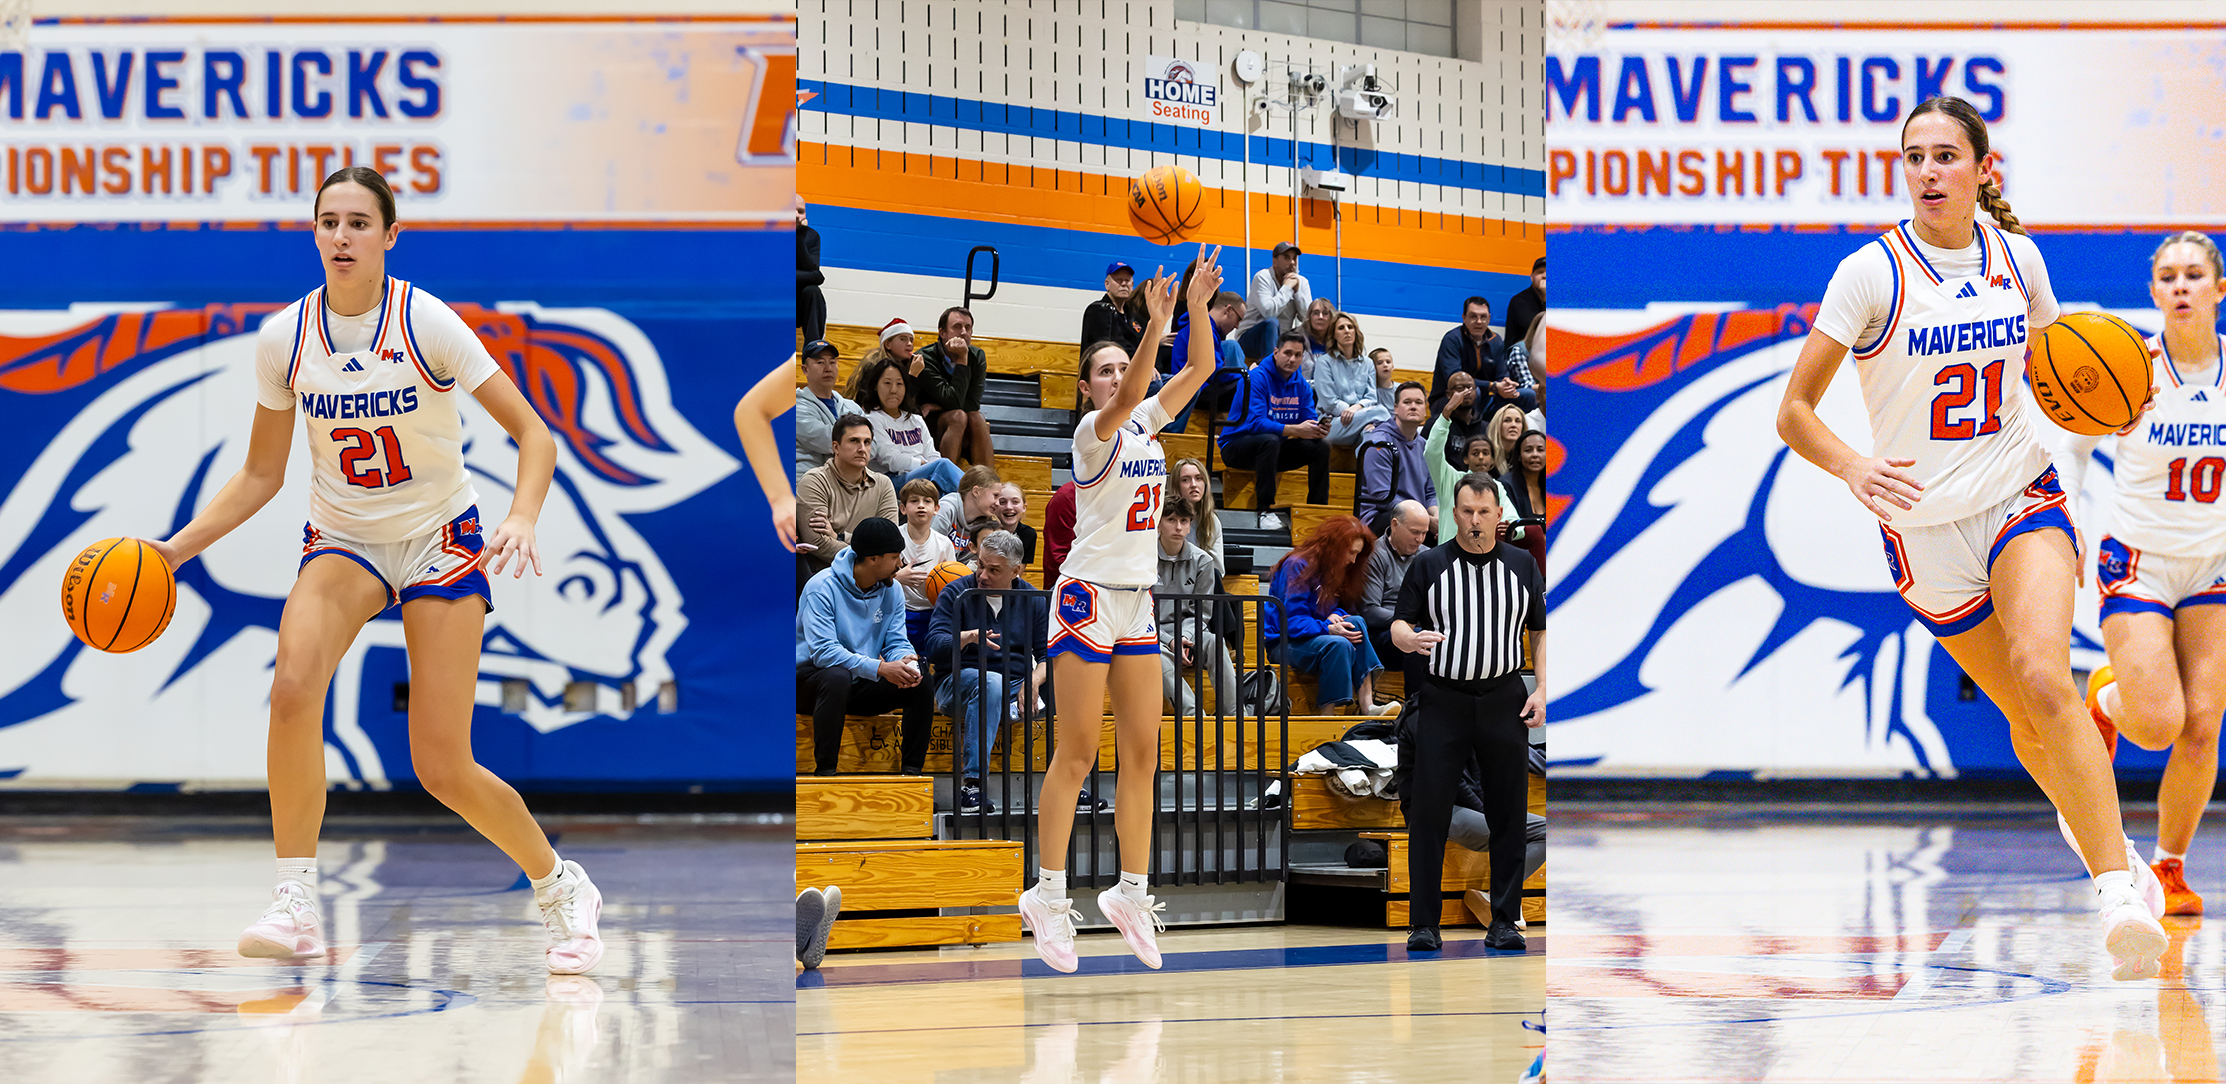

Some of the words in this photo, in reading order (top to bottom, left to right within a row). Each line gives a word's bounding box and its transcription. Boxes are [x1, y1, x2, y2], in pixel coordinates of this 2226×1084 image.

[1149, 78, 1215, 106] HOME
[1152, 100, 1210, 126] Seating
[1989, 274, 2013, 291] MR
[1907, 313, 2026, 356] MAVERICKS
[380, 348, 405, 364] MR
[300, 385, 419, 420] MAVERICKS
[1929, 358, 2006, 441] 21
[329, 425, 413, 489] 21
[2164, 456, 2226, 504] 10
[1125, 482, 1163, 533] 21
[65, 547, 102, 621] Wilson
[1061, 593, 1087, 614] MR
